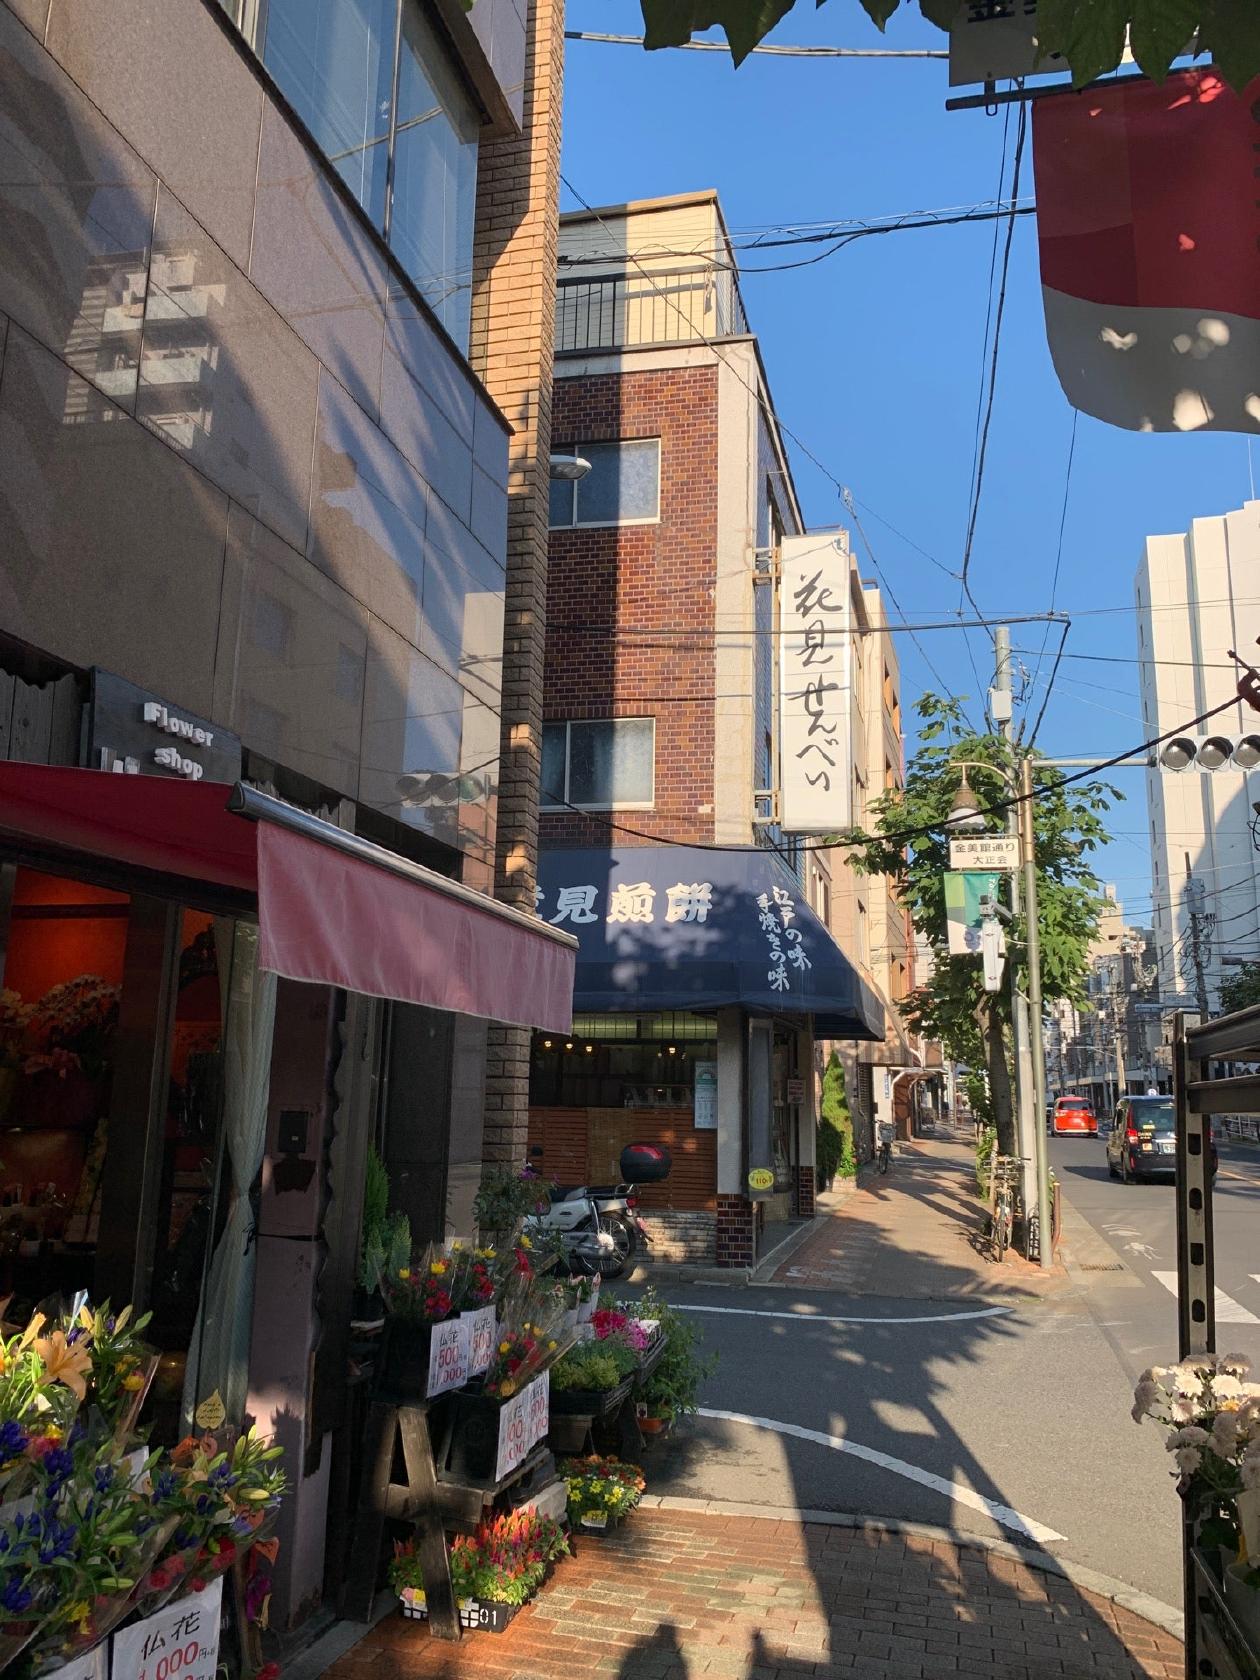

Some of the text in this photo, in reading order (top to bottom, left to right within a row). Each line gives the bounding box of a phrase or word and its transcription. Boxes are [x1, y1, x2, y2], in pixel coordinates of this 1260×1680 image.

[788, 569, 843, 792] 花見せんべい
[144, 702, 214, 747] Flower
[973, 856, 1007, 865] 大正会
[536, 882, 713, 924] 見煎餅
[772, 885, 812, 970] 江戸の味
[756, 893, 790, 992] 手焼きの味
[141, 1610, 200, 1660] 仏花
